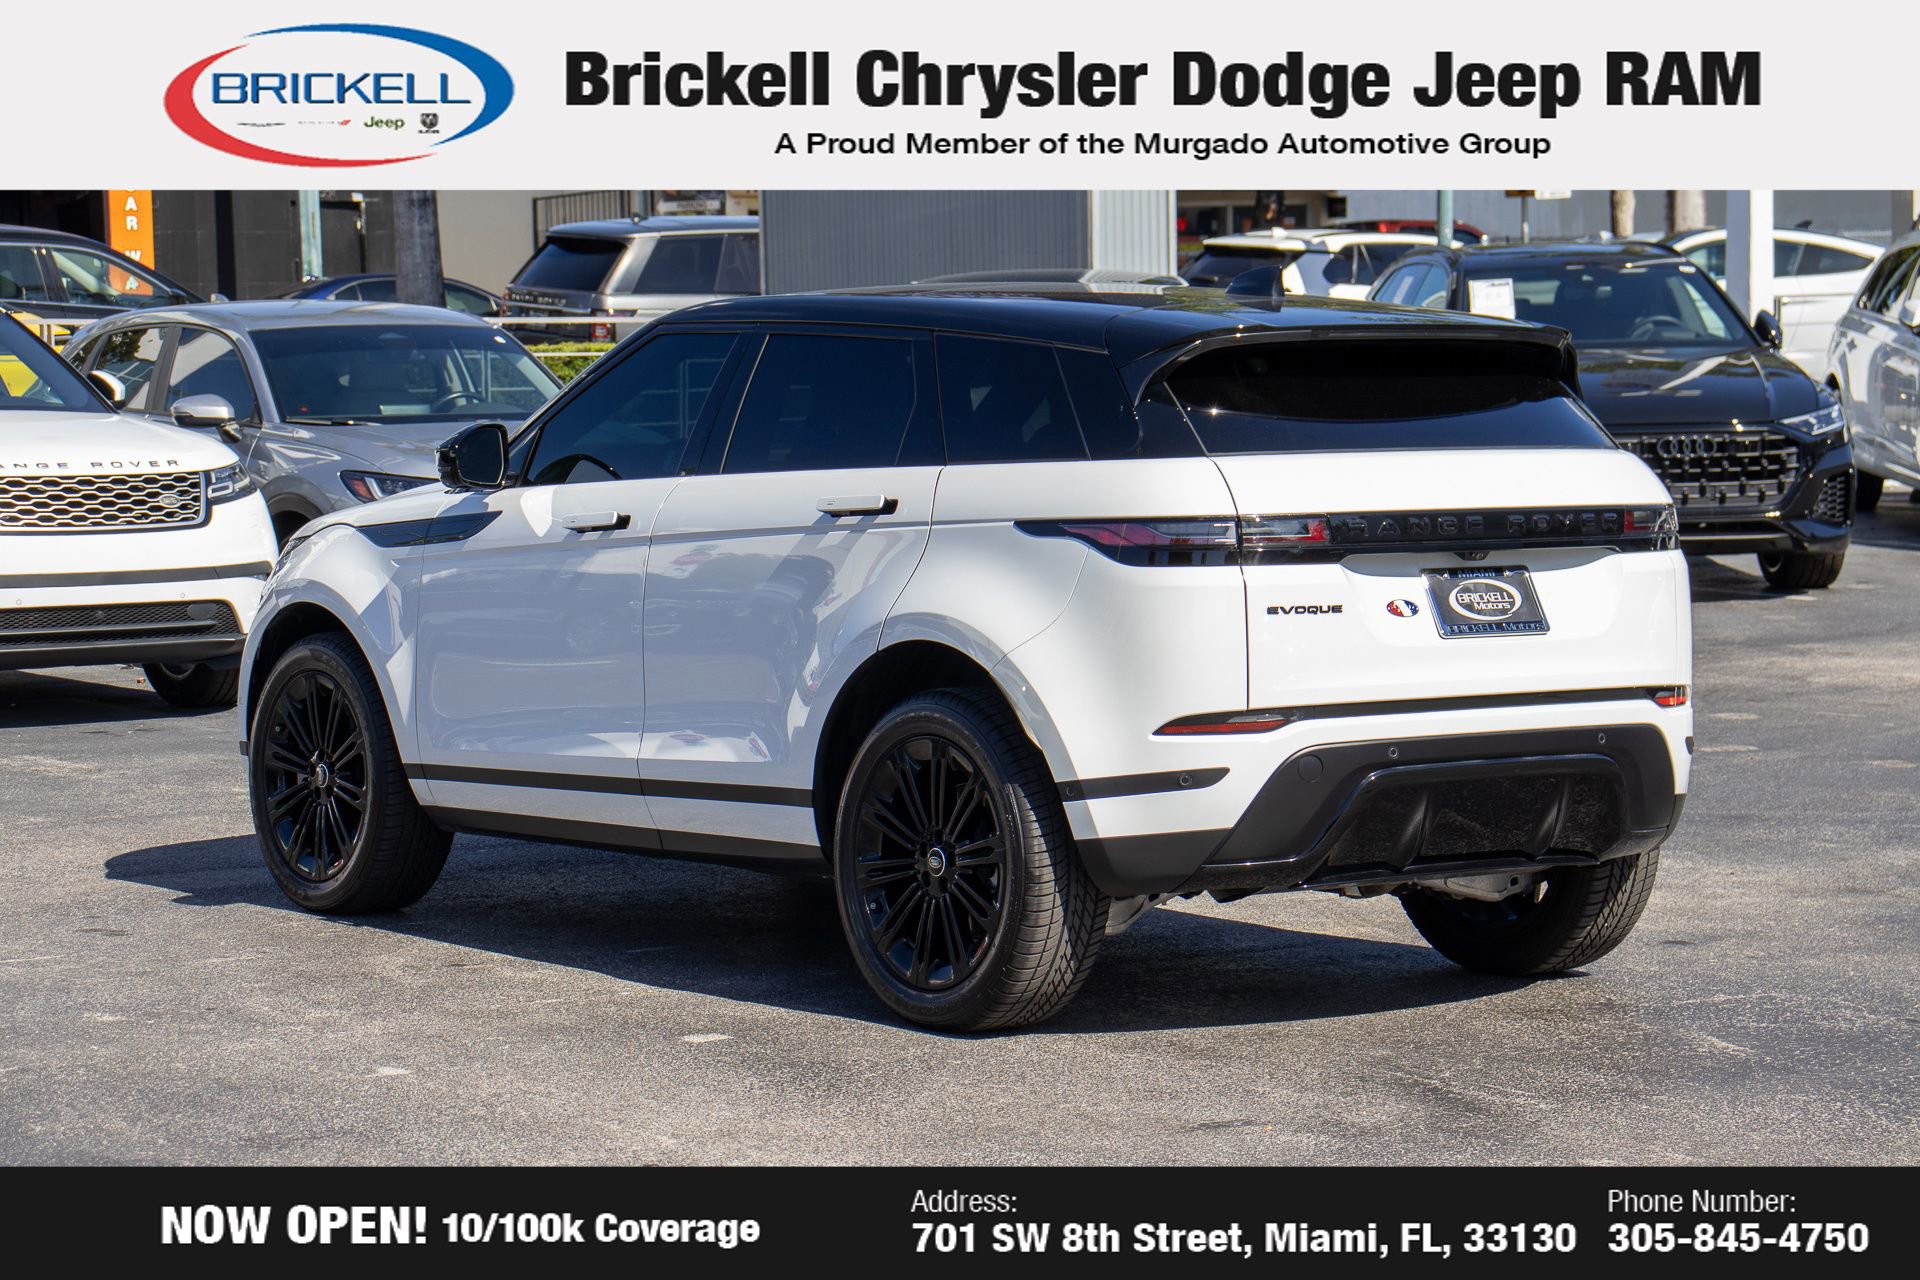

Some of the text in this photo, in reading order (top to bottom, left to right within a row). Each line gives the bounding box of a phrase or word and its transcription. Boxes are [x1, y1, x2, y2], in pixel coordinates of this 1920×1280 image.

[124, 189, 139, 231] AR
[0, 459, 180, 470] NGE ROVER
[1346, 512, 1619, 537] RANGE ROVER
[1457, 592, 1514, 604] BRICKELL
[1266, 604, 1343, 615] EVOQUE
[1474, 602, 1511, 611] Motors
[1448, 622, 1545, 633] BRICKELL Motors
